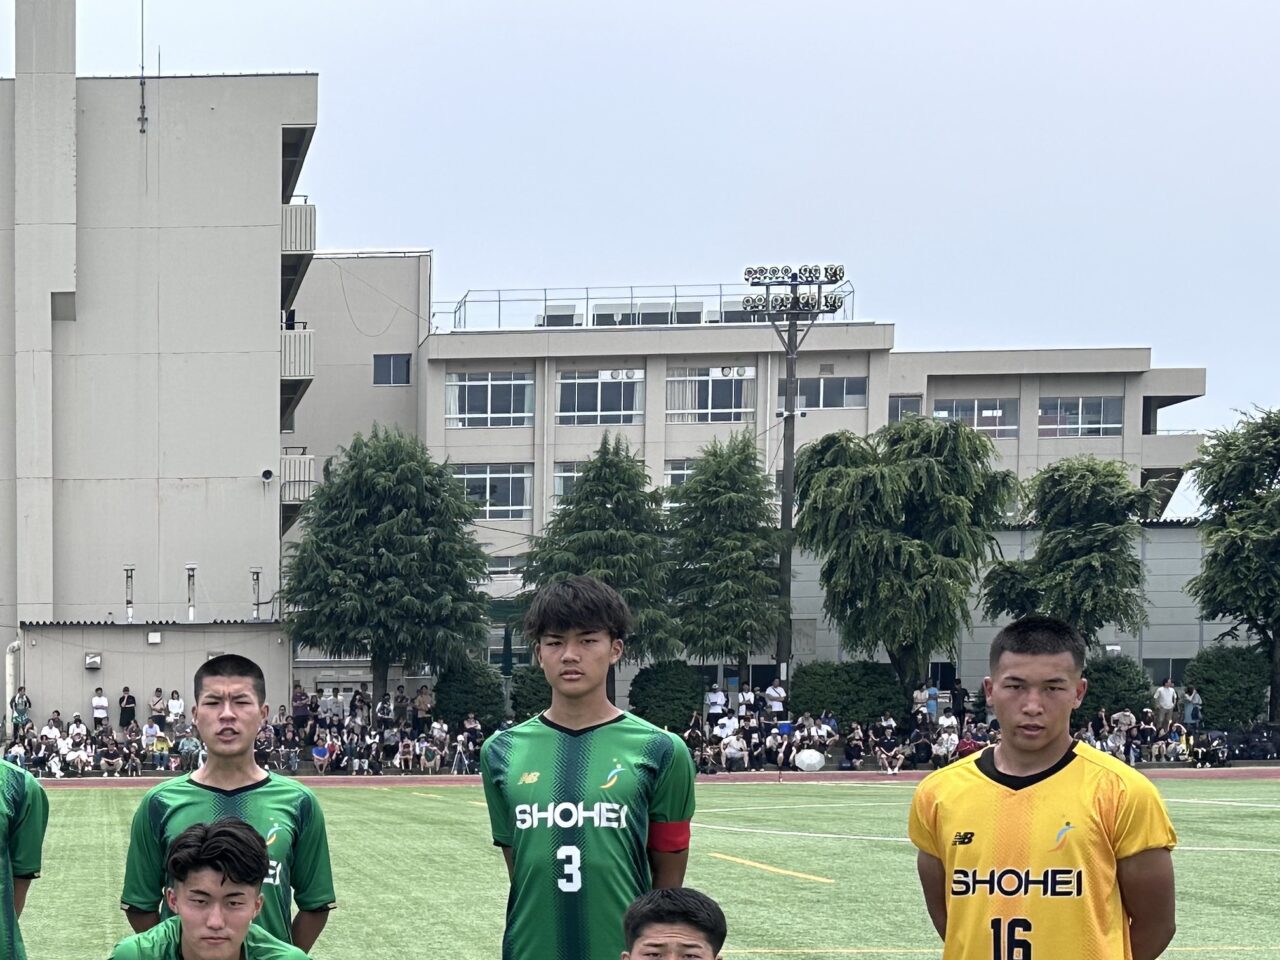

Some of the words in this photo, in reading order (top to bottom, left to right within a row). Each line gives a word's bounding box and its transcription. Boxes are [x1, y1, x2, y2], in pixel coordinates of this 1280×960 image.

[515, 801, 628, 830] SHOHEI
[556, 845, 582, 892] 3
[951, 867, 1083, 897] SHOHEI
